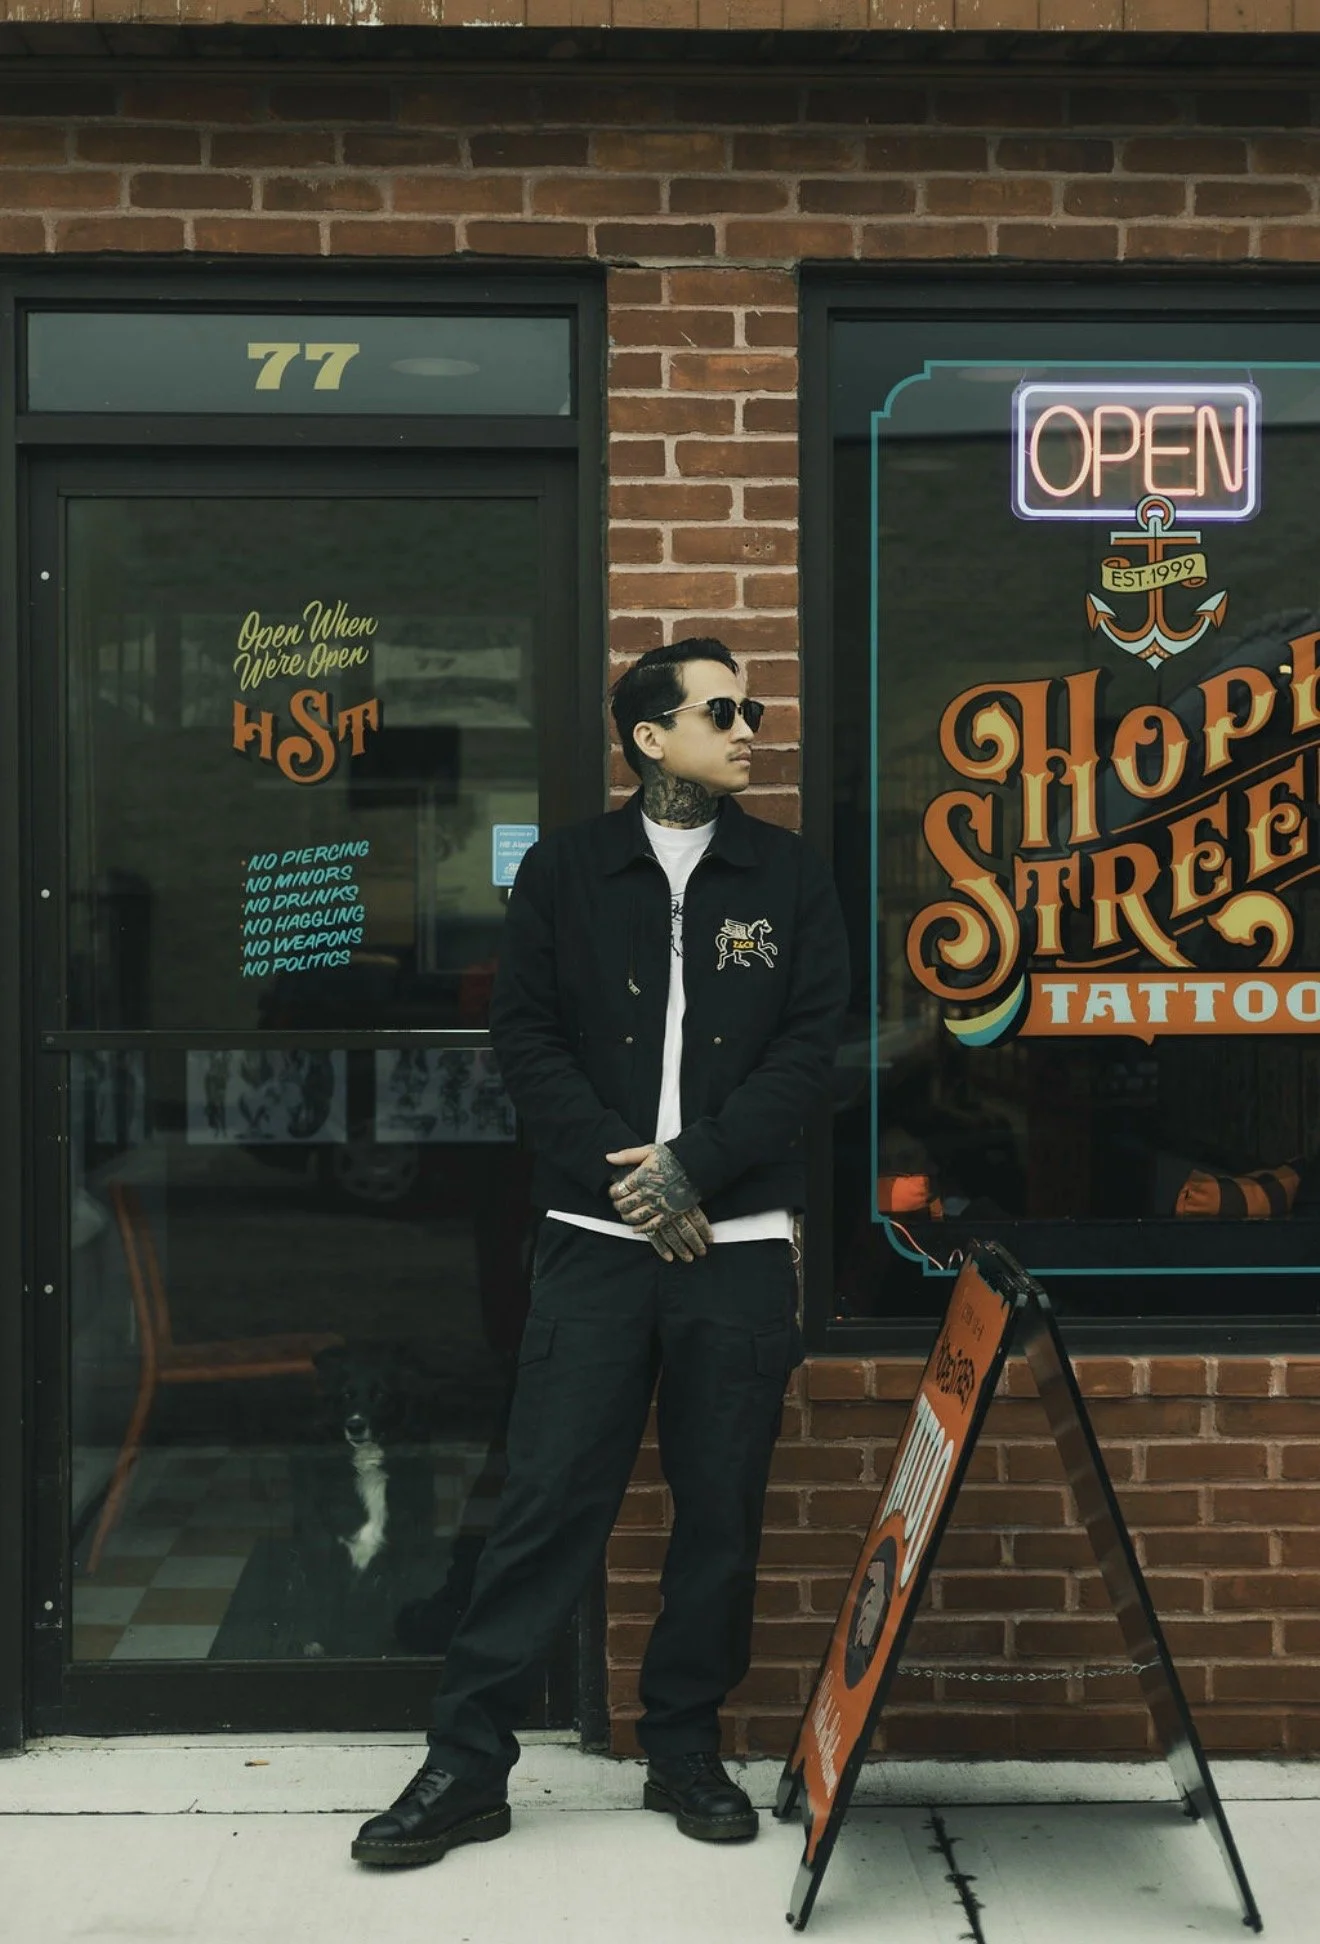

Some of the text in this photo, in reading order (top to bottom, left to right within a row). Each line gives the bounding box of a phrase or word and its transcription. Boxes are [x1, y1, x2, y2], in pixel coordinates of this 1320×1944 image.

[247, 342, 360, 390] 77
[1029, 405, 1245, 498] OPEN
[238, 600, 379, 655] Open When
[233, 643, 370, 692] We're Open
[232, 689, 379, 783] HST
[248, 840, 369, 872] NO PIERCING
[906, 748, 1320, 1001] STREE
[244, 885, 359, 915] NO DRUNKS
[246, 865, 353, 893] NO MINORS
[243, 905, 365, 937] NO HAGGLING
[243, 927, 363, 958] NO WEAPONS
[243, 949, 351, 978] NO POLITICS
[1041, 980, 1320, 1023] TATTOO
[878, 1391, 955, 1589] TATTOO
